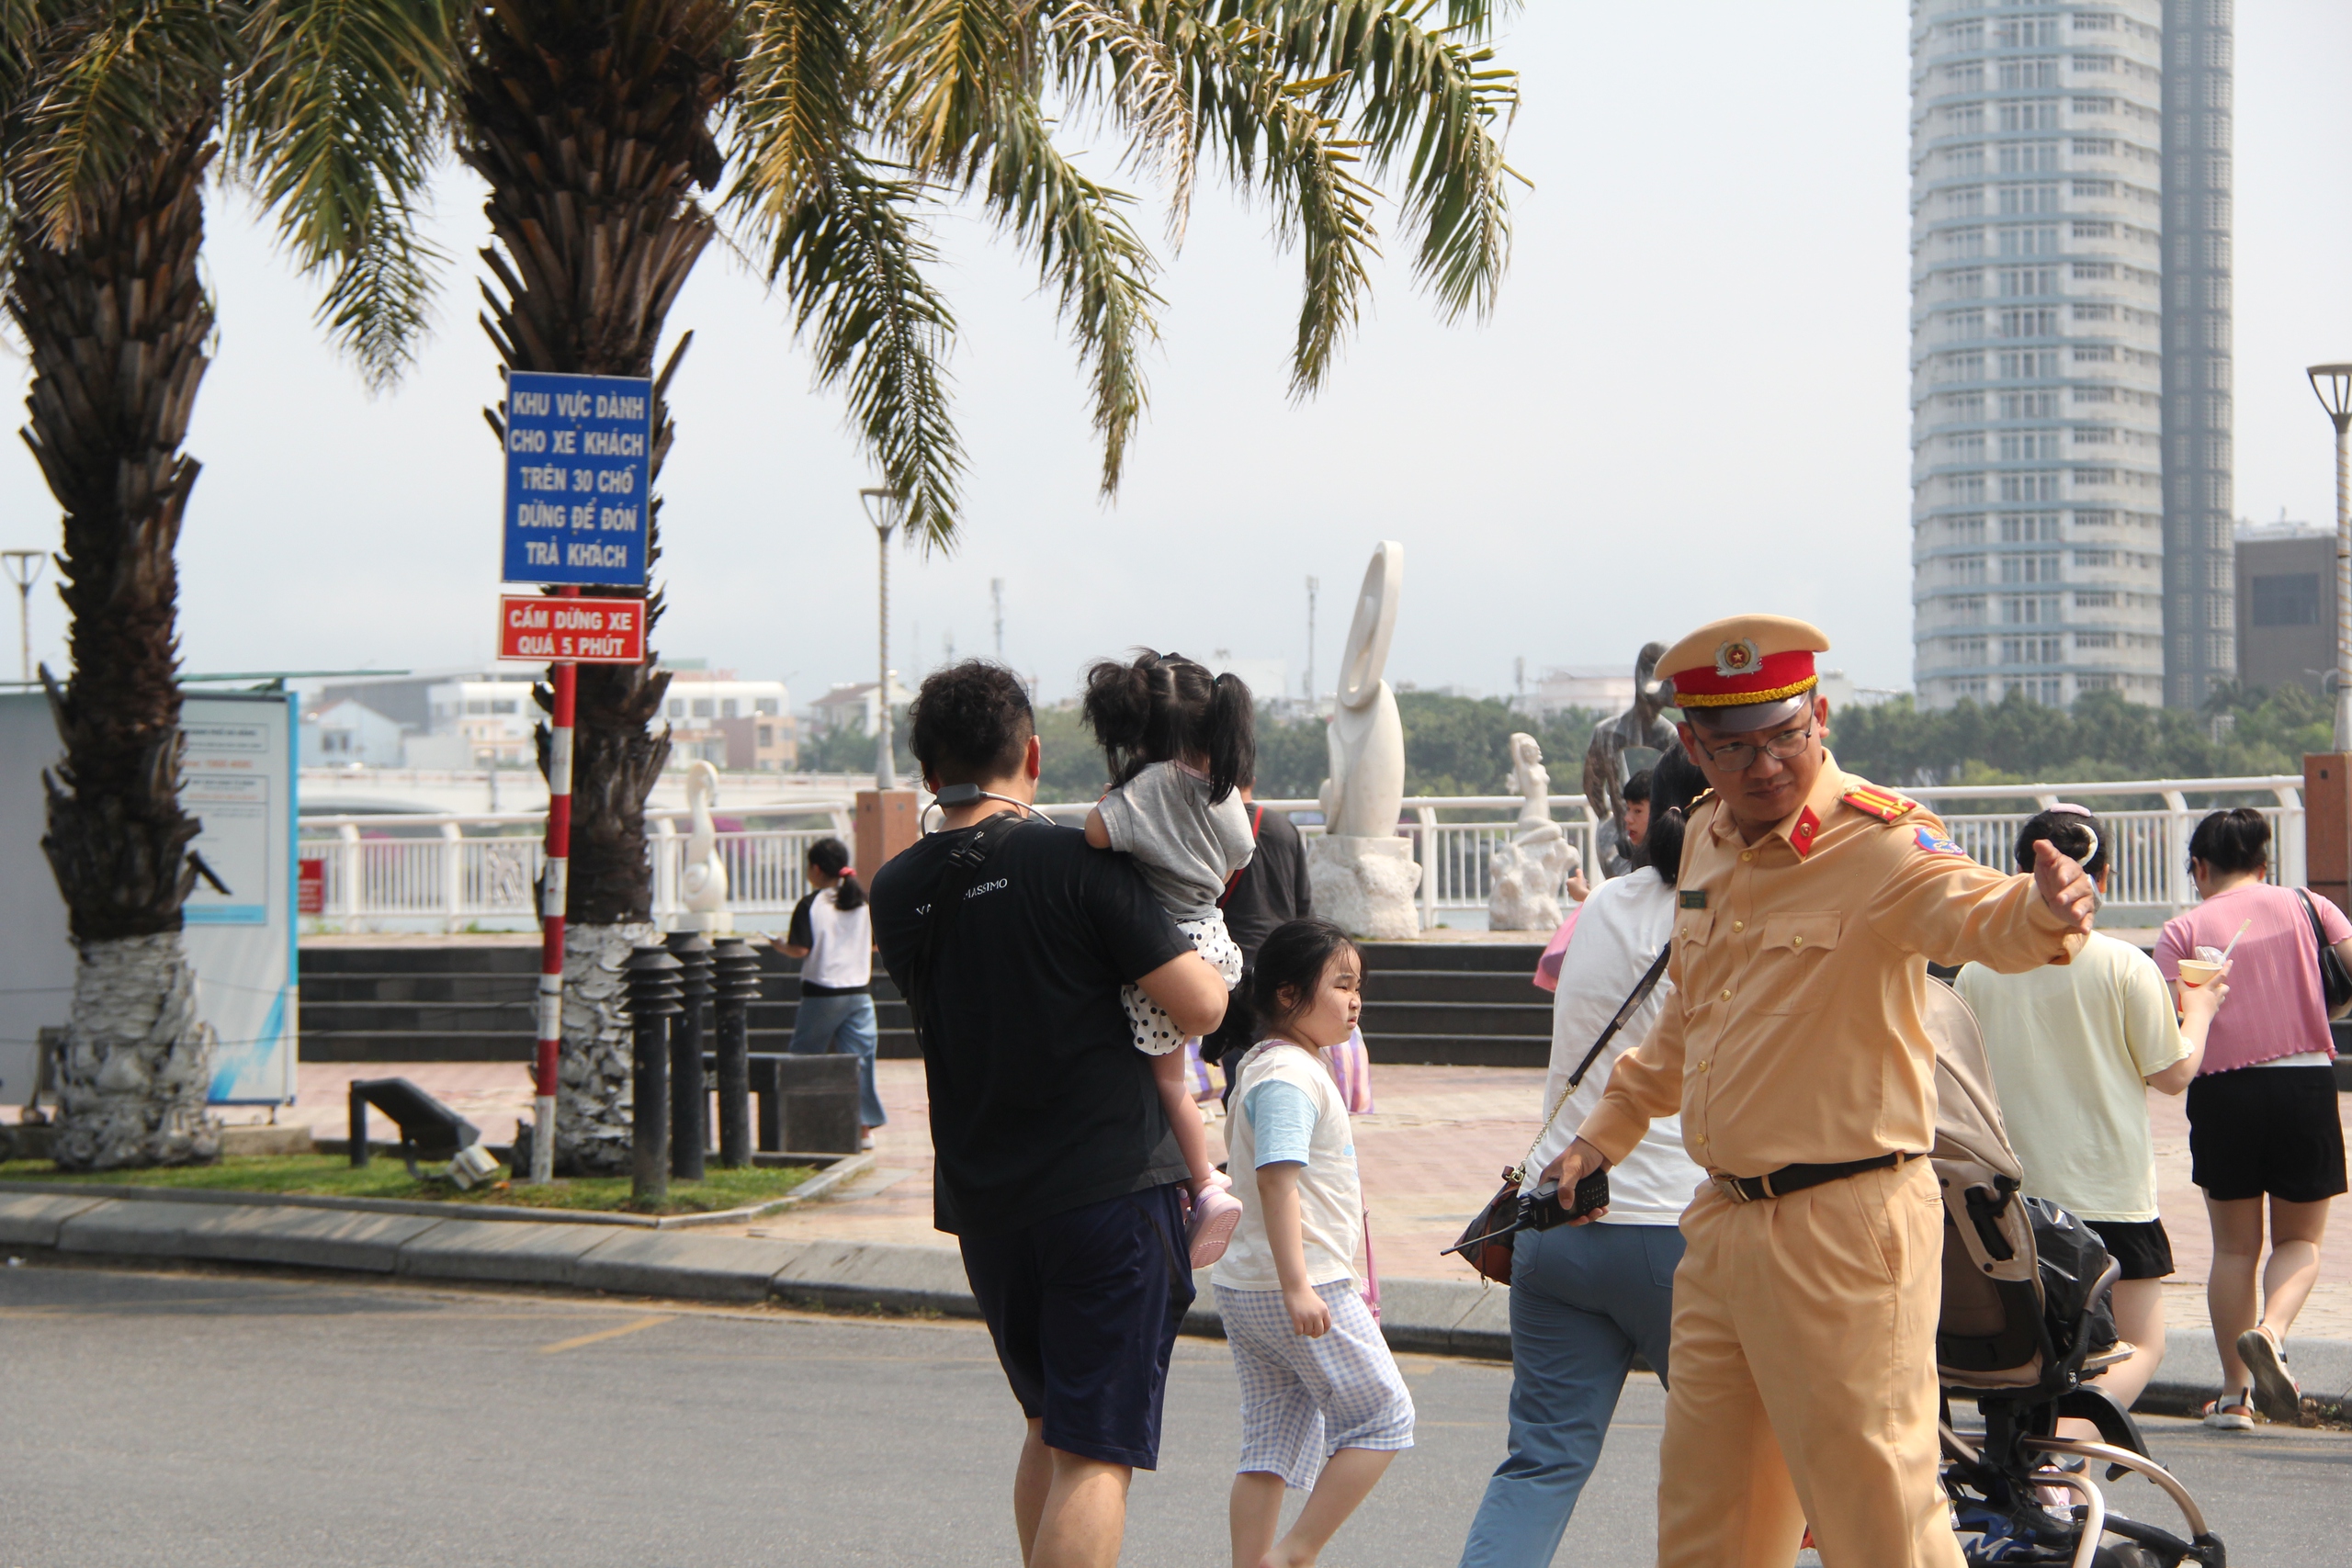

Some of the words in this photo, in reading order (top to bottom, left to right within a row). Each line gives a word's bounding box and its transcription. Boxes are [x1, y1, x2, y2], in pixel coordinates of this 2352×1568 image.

[513, 391, 550, 416] KHU
[556, 389, 593, 422] VỰC
[595, 390, 645, 420] DÀNH
[510, 429, 547, 453] CHO
[552, 430, 577, 454] XE
[583, 427, 644, 457] KHÁCH
[520, 462, 567, 491] TRÊN
[572, 468, 594, 492] 30
[598, 464, 638, 494] CHỖ
[517, 498, 567, 528] DỪNG
[571, 497, 597, 530] ĐỂ
[525, 536, 560, 565] TRẢ
[567, 538, 628, 568] KHÁCH
[509, 604, 549, 628] CẤM
[554, 606, 603, 630] DỪNG
[608, 612, 633, 630] XE
[517, 632, 556, 655] QUÁ
[561, 637, 573, 655] 5
[578, 634, 626, 656] PHÚT
